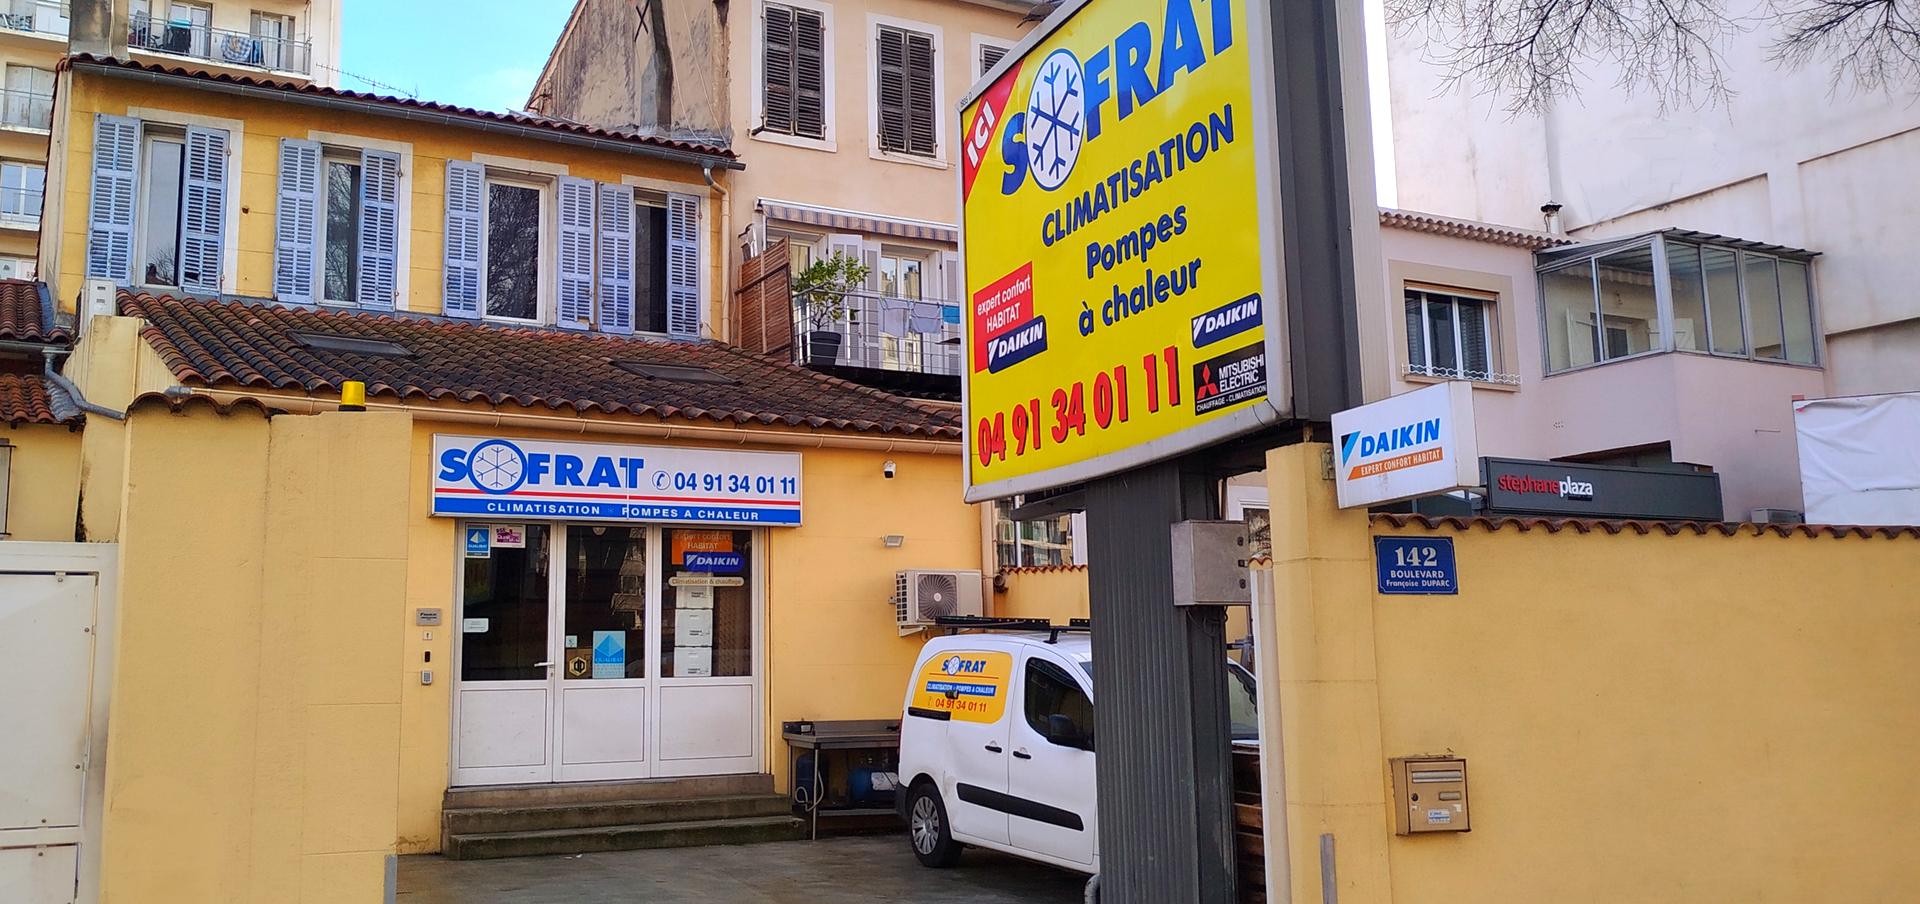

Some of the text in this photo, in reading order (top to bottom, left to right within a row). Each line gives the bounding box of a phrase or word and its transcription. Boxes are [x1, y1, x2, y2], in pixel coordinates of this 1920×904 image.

[966, 100, 998, 168] ICI
[1042, 103, 1234, 247] CLIMATISATION
[1086, 205, 1188, 279] Pompes
[977, 273, 1031, 316] expert confort
[1078, 257, 1202, 337] à chaleur
[986, 301, 1021, 334] HABITAT
[1205, 298, 1258, 334] DAIKIN
[998, 321, 1044, 358] DAIKIN
[1218, 353, 1264, 380] MITSUBISHI
[1219, 369, 1259, 392] ELECTRIC
[1196, 397, 1225, 412] CHAUFFAGE
[1228, 384, 1267, 402] CLIMATISATION
[978, 411, 1006, 467] 04
[1011, 397, 1041, 456] 91
[1051, 381, 1086, 443] 34
[1093, 364, 1128, 429] 01
[1361, 417, 1440, 458] DAIKIN
[438, 439, 796, 495] SOFRAT 04 91 34 01 11
[1361, 449, 1440, 476] EXPERT CONFORT HABITAT
[487, 502, 759, 520] CLIMATISATION POMPES A CHALEUR
[674, 532, 730, 541] expert confort
[687, 542, 719, 550] HABITAT
[696, 556, 740, 566] DAIKIN
[1394, 546, 1438, 567] 142
[715, 578, 742, 586] chauffage
[1386, 579, 1450, 588] Françoise DUPARC
[1390, 570, 1444, 579] BOULEVARD
[941, 655, 987, 676] SOFRAT
[927, 683, 953, 691] CLIMATISATION
[975, 686, 995, 694] CHALEUR
[935, 698, 987, 713] 04 91 34 01 11
